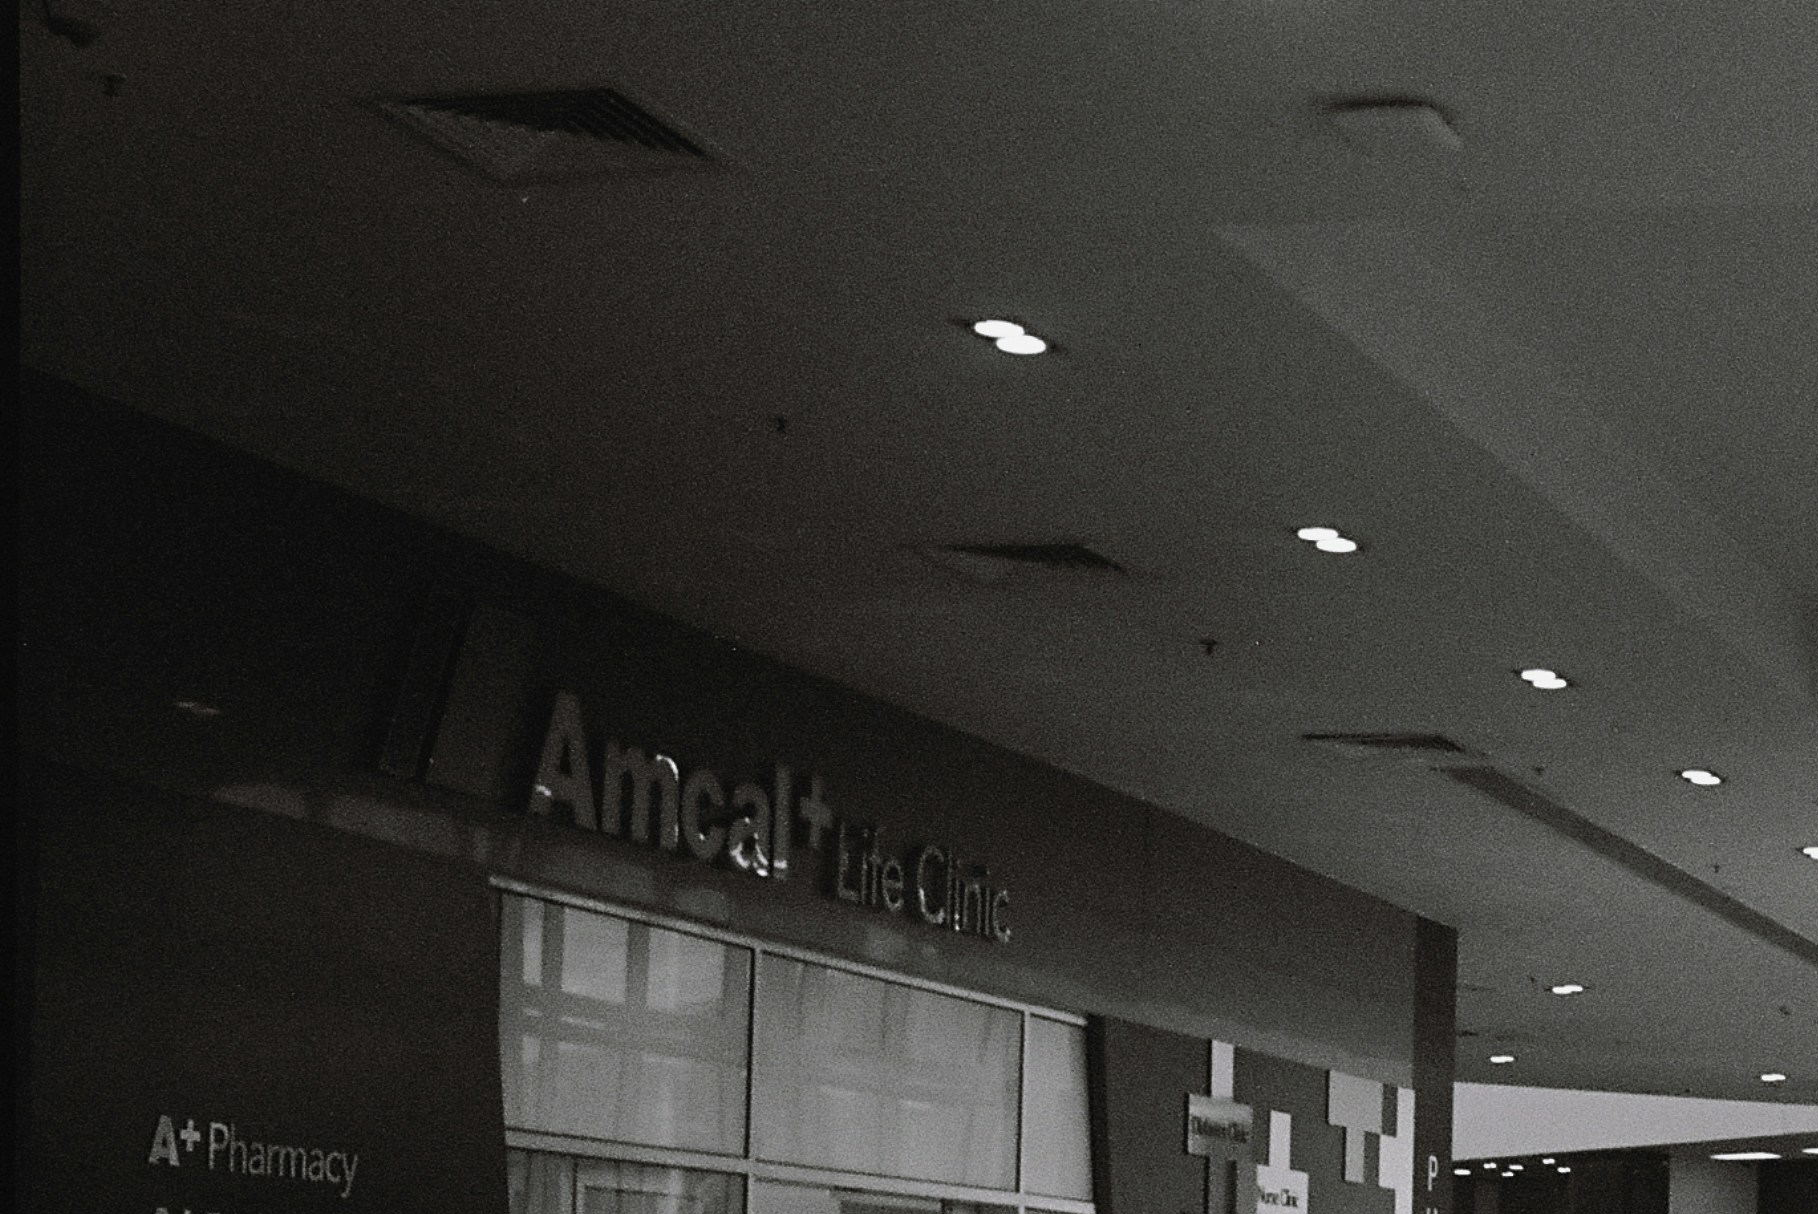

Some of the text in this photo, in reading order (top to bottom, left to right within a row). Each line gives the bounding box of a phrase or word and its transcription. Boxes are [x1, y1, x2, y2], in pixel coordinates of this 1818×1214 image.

[837, 822, 904, 912] Life
[917, 845, 1011, 942] Clinic
[207, 1121, 359, 1199] Pharmacy
